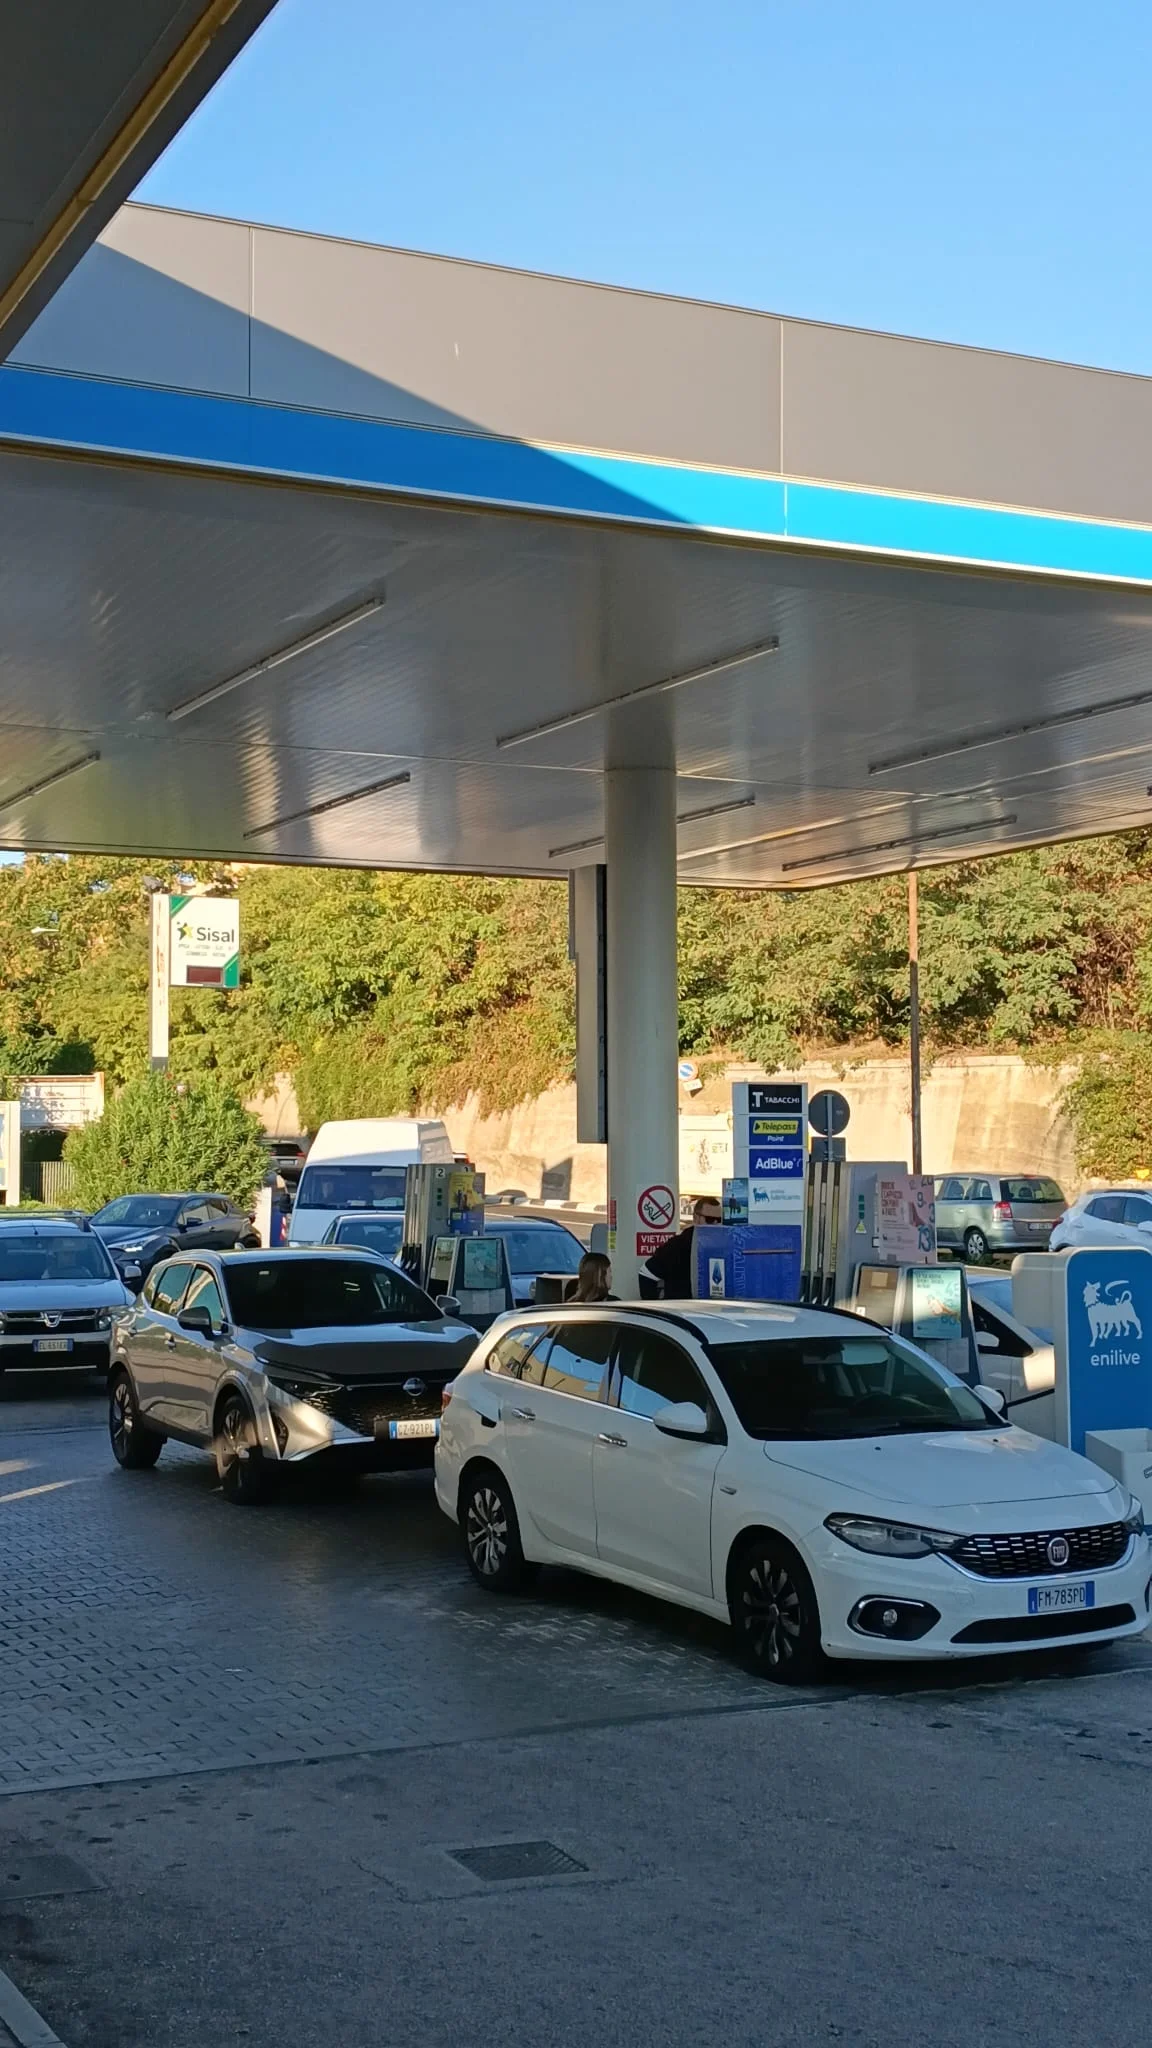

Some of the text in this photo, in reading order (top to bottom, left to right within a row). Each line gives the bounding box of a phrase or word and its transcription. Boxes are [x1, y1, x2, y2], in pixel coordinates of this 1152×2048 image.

[196, 927, 234, 943] Sisal
[761, 1122, 796, 1131] Telepass
[641, 1234, 674, 1243] VIETAT
[1090, 1350, 1140, 1366] enilive
